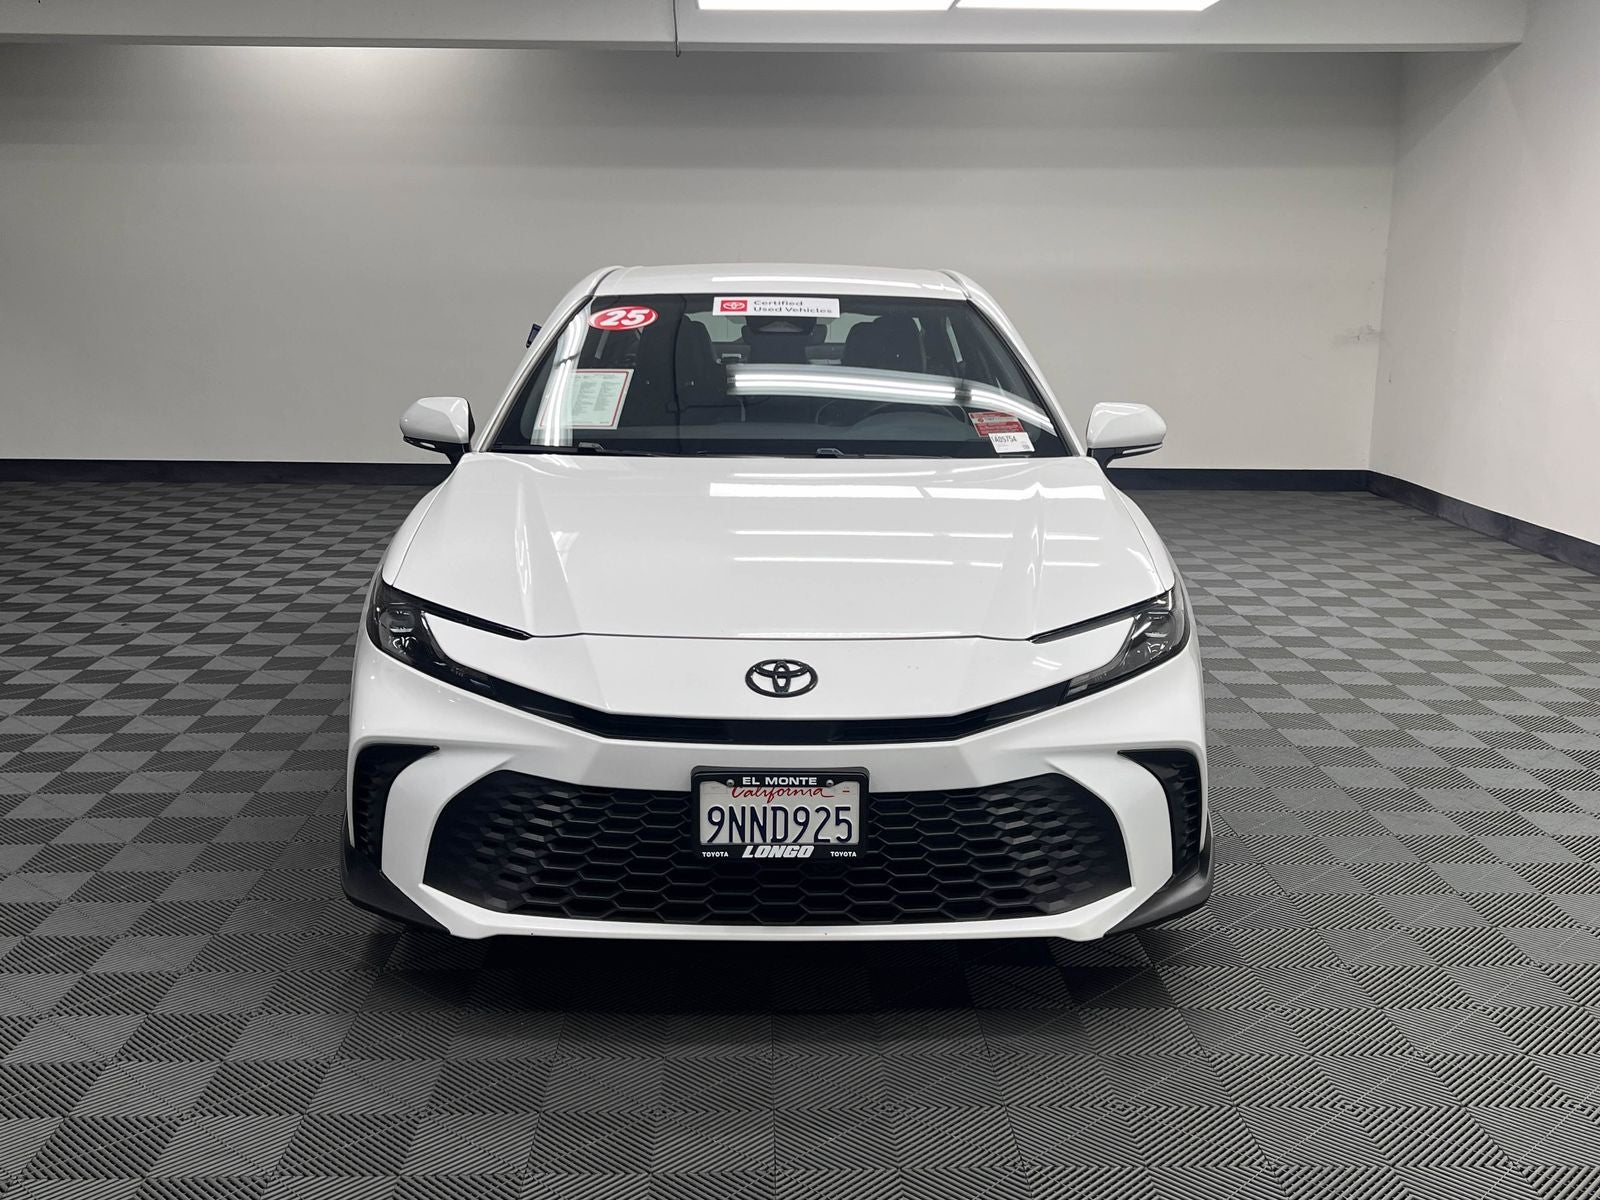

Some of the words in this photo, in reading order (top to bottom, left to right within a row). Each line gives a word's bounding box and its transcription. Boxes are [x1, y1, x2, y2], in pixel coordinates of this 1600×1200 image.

[599, 308, 651, 327] 25
[742, 776, 761, 786] EL
[765, 776, 818, 786] MONTE
[731, 786, 834, 804] California
[707, 805, 853, 844] 9NND925
[741, 845, 815, 859] LONGO
